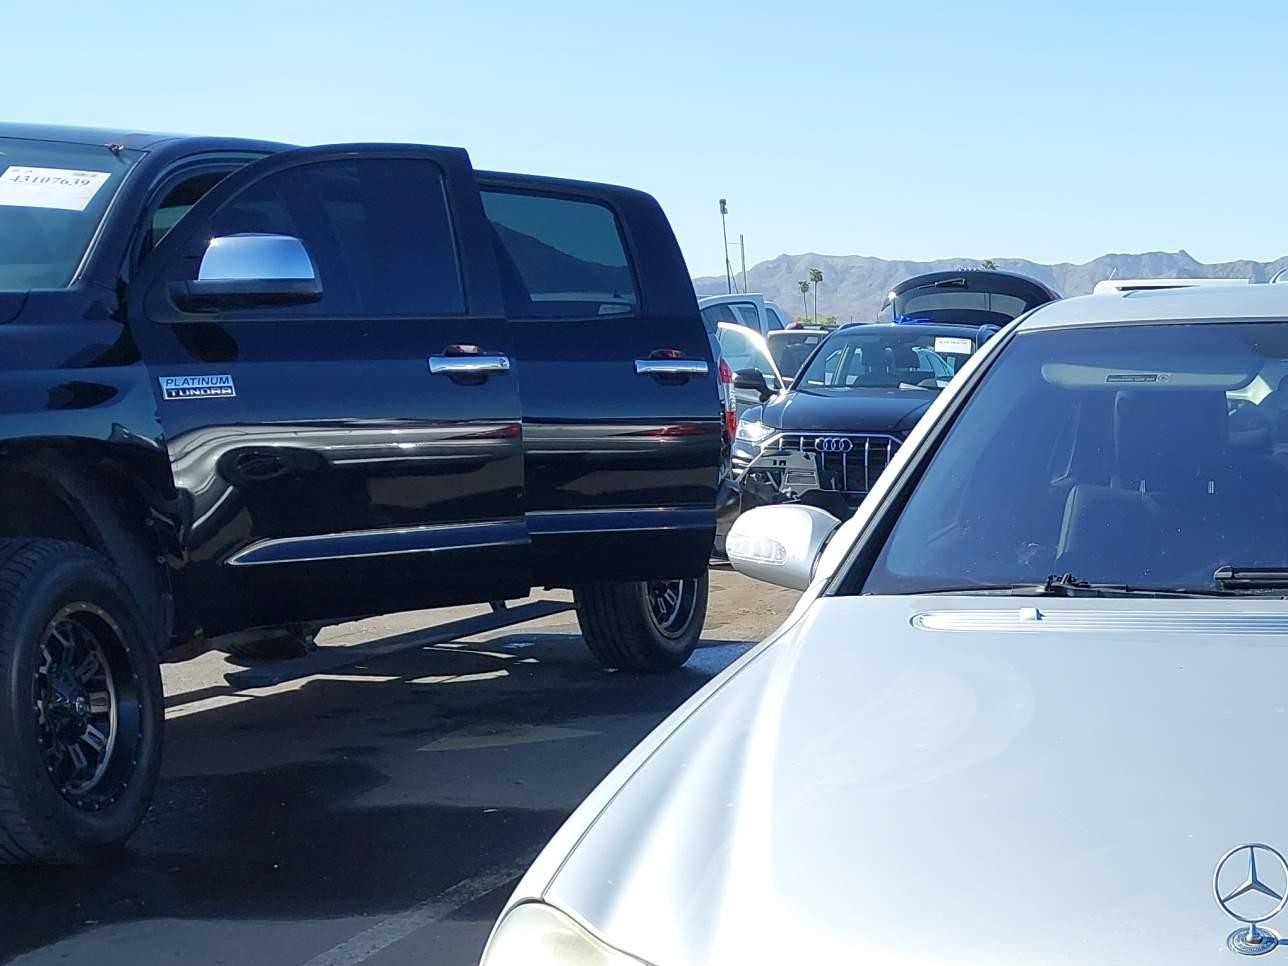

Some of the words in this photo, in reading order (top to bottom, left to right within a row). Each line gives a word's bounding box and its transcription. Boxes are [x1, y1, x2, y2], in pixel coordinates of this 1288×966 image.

[10, 175, 91, 186] 43107639
[166, 376, 230, 387] PLATINUM
[168, 387, 232, 397] TUNDRA
